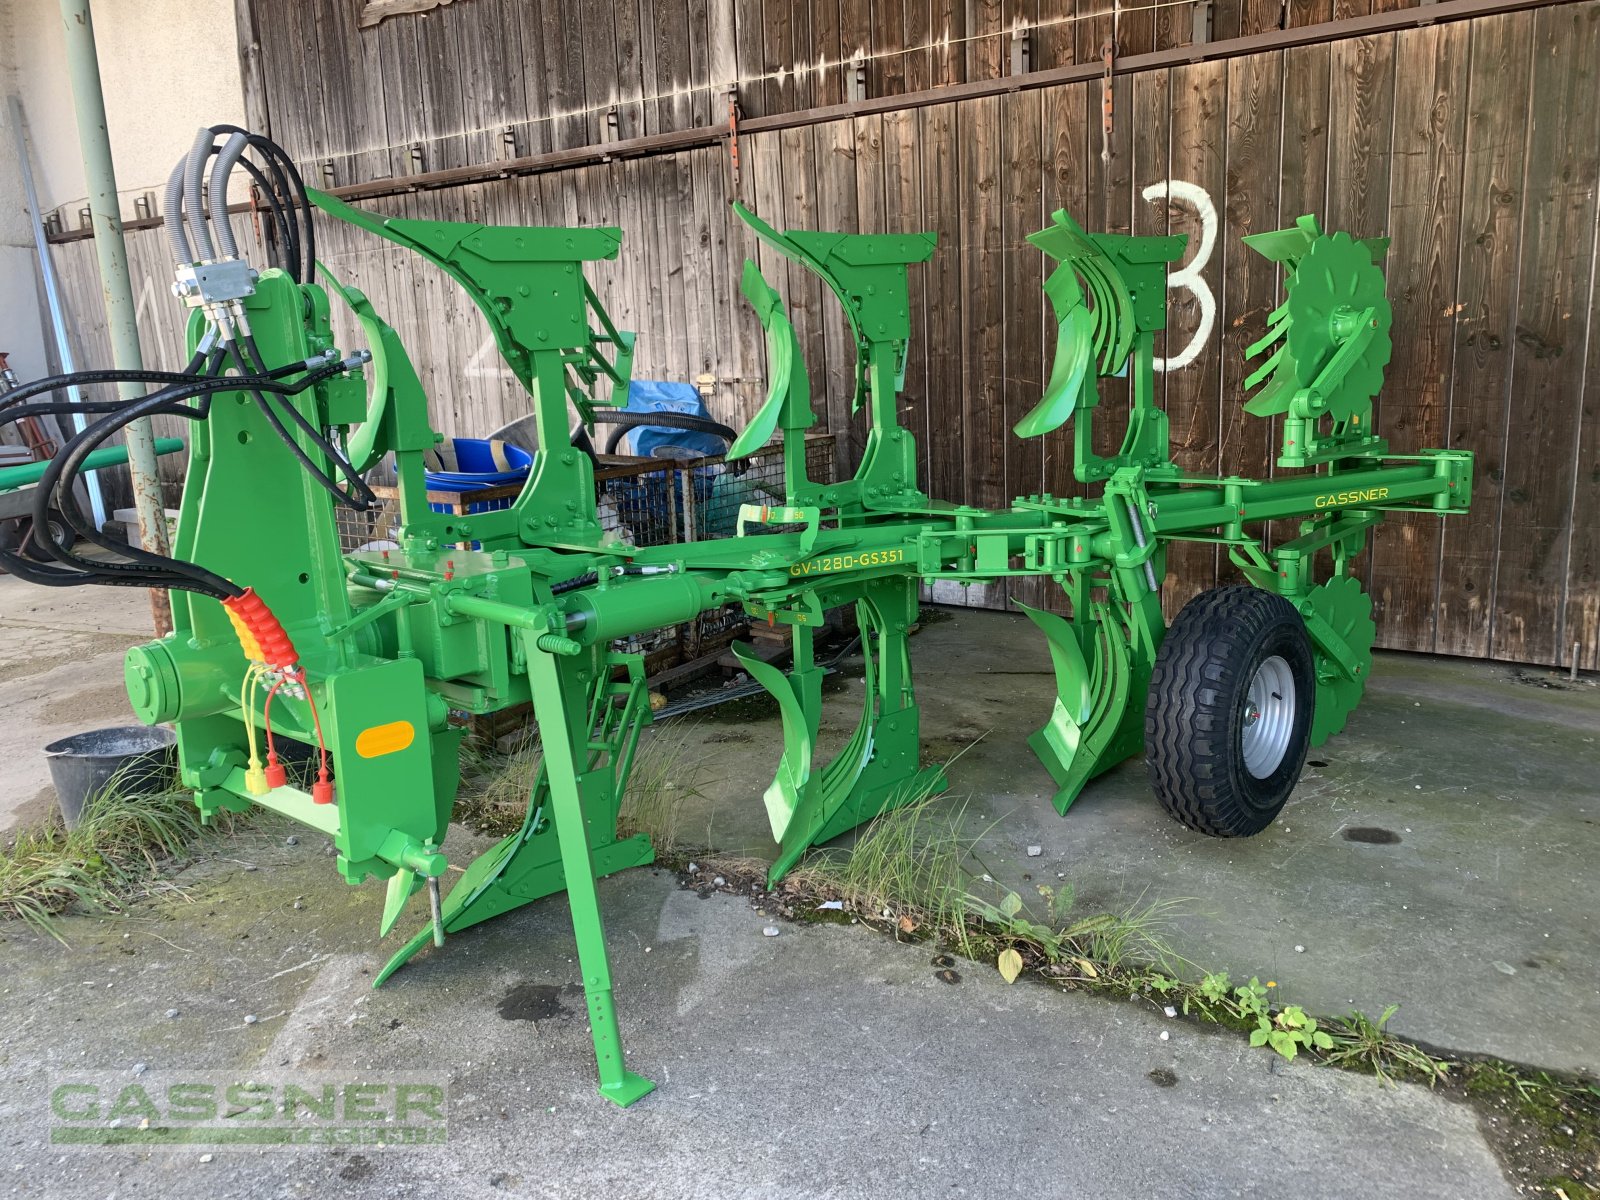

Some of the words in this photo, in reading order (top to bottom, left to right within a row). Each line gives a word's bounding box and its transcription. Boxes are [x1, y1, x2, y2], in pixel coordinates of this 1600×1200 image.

[1142, 180, 1218, 372] 3
[1315, 488, 1389, 508] GASSNER
[790, 550, 903, 576] GV-1280-GS351
